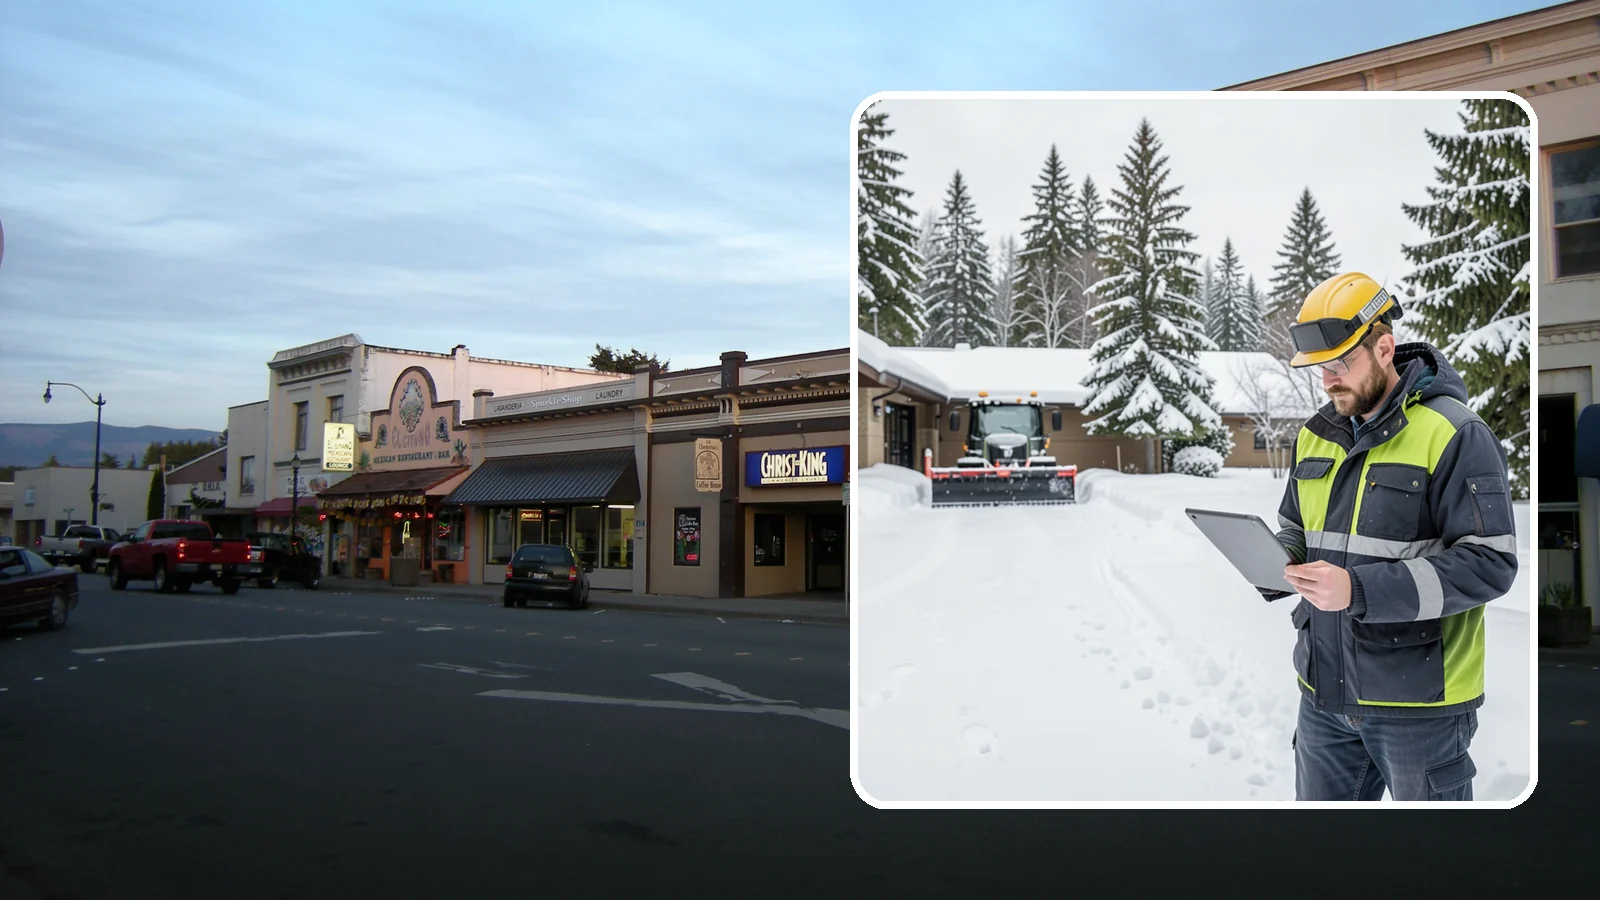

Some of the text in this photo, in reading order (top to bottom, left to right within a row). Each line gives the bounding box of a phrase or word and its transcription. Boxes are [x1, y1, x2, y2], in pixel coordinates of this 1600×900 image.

[493, 402, 522, 412] LAVANDERIA
[561, 395, 582, 406] Shop
[595, 389, 623, 400] LAUNDRY
[373, 454, 396, 464] MEXICAN
[397, 451, 433, 462] RESTAURANT
[437, 450, 450, 459] BAR
[761, 452, 797, 478] CHRIST
[799, 450, 827, 476] KING
[696, 481, 722, 489] Coffee House
